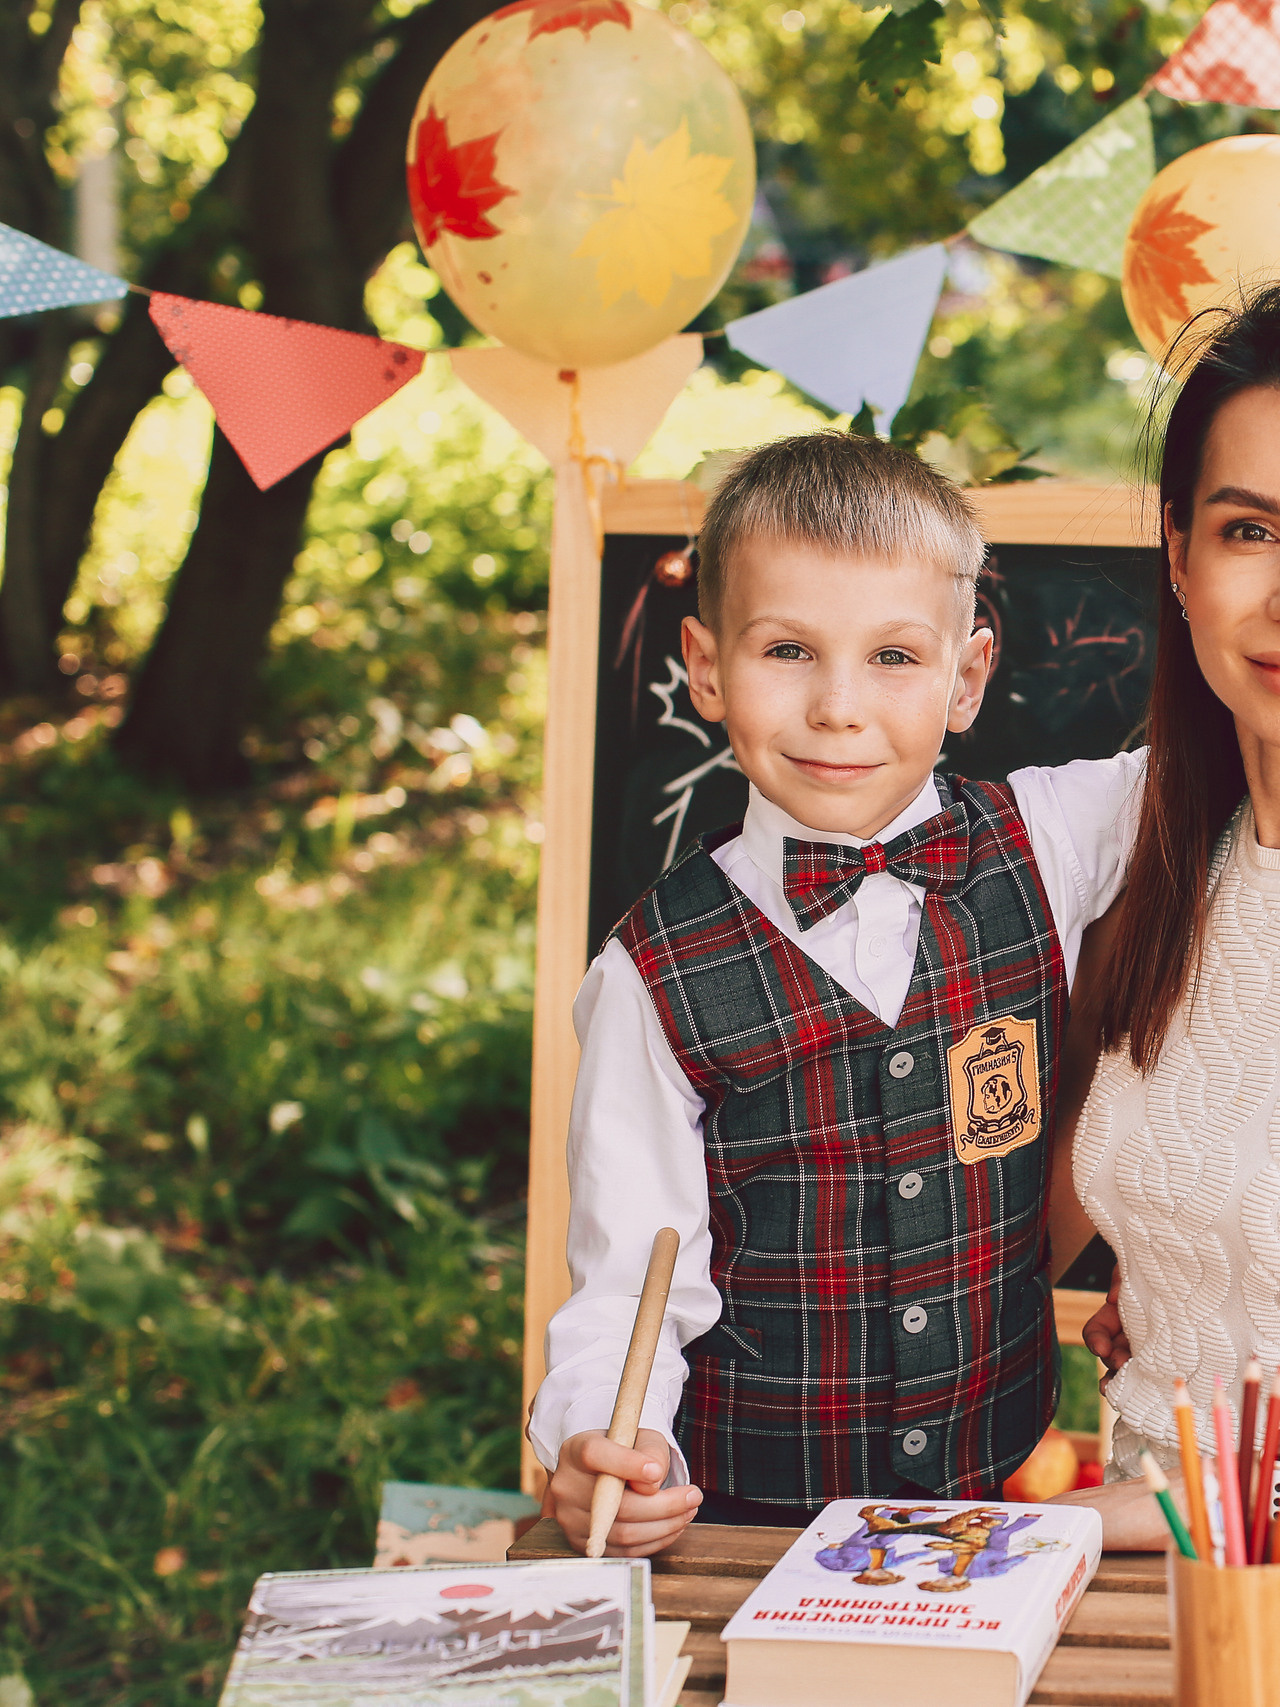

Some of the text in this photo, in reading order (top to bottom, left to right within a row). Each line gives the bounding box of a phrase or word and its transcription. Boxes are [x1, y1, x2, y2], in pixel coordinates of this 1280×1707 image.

[972, 1050, 1018, 1077] ГИМНАЗИЯ 5
[798, 1597, 976, 1615] ЭЛЕКТРОНИКА
[752, 1609, 952, 1629] ПРИКЛЮЧЕНИЯ
